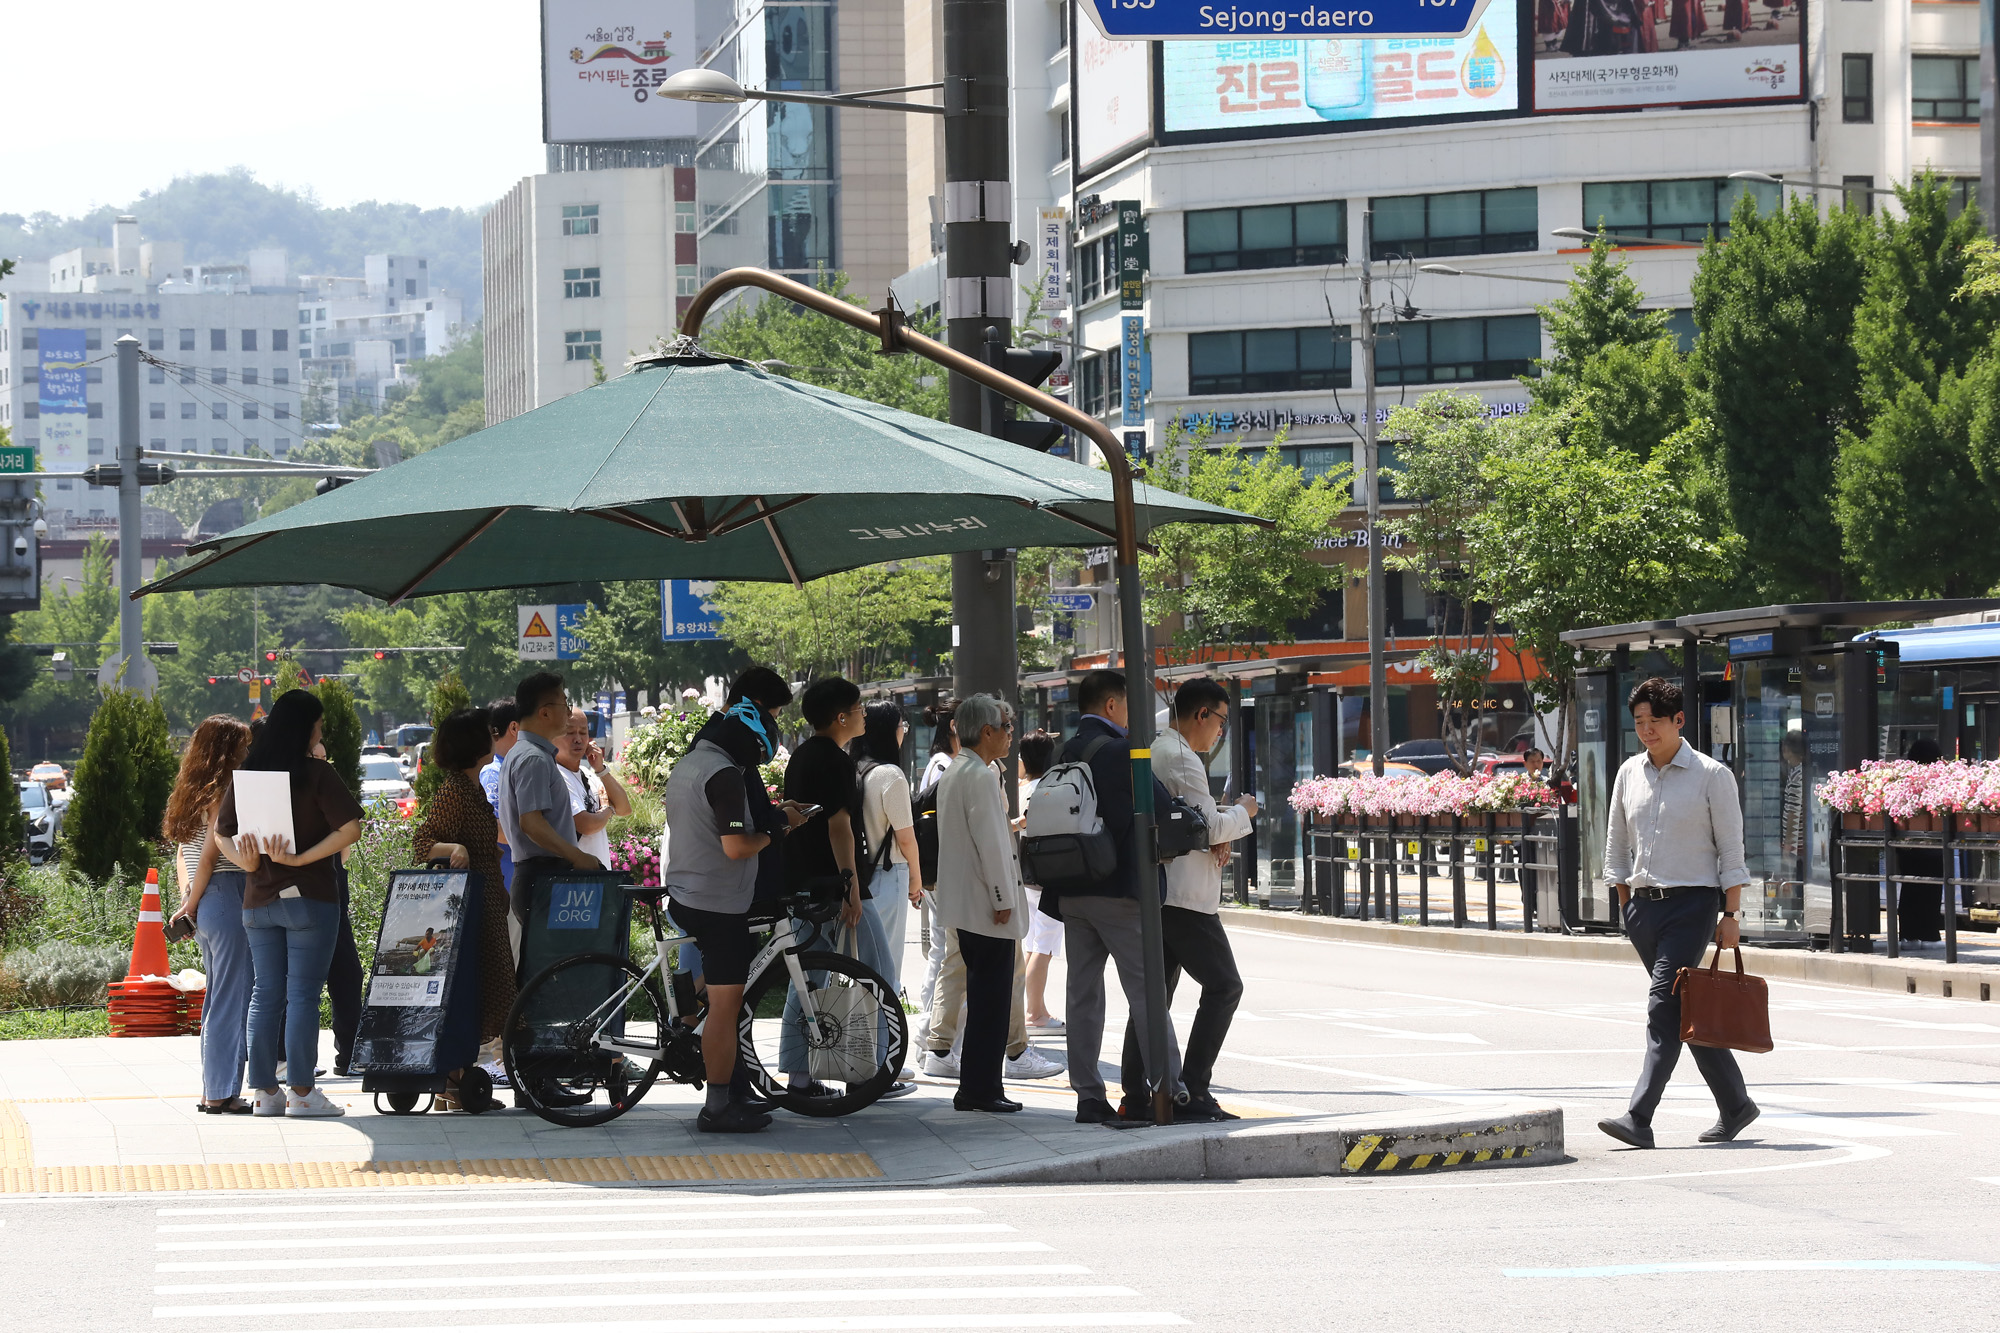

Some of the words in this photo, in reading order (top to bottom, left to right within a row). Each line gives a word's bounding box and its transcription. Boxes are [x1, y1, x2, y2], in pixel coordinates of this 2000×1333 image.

[1199, 5, 1374, 32] Sejong-daero
[585, 27, 613, 42] 서울의
[614, 26, 635, 41] 심장
[1372, 51, 1459, 103] 골드
[1548, 64, 1679, 84] 사직대제(국가무형문화재)
[579, 70, 604, 83] 다시
[606, 69, 630, 88] 뛰는
[632, 68, 667, 103] 종로
[1215, 61, 1301, 113] 진로
[1045, 222, 1061, 299] 국제회계학원
[45, 302, 160, 320] 서울특별시교육청
[1128, 318, 1141, 413] 유정이비인후과
[1051, 373, 1066, 386] 3F
[849, 515, 988, 540] 그늘나누리
[676, 622, 718, 634] 중앙차로
[560, 890, 594, 907] JW
[555, 909, 591, 922] .ORG
